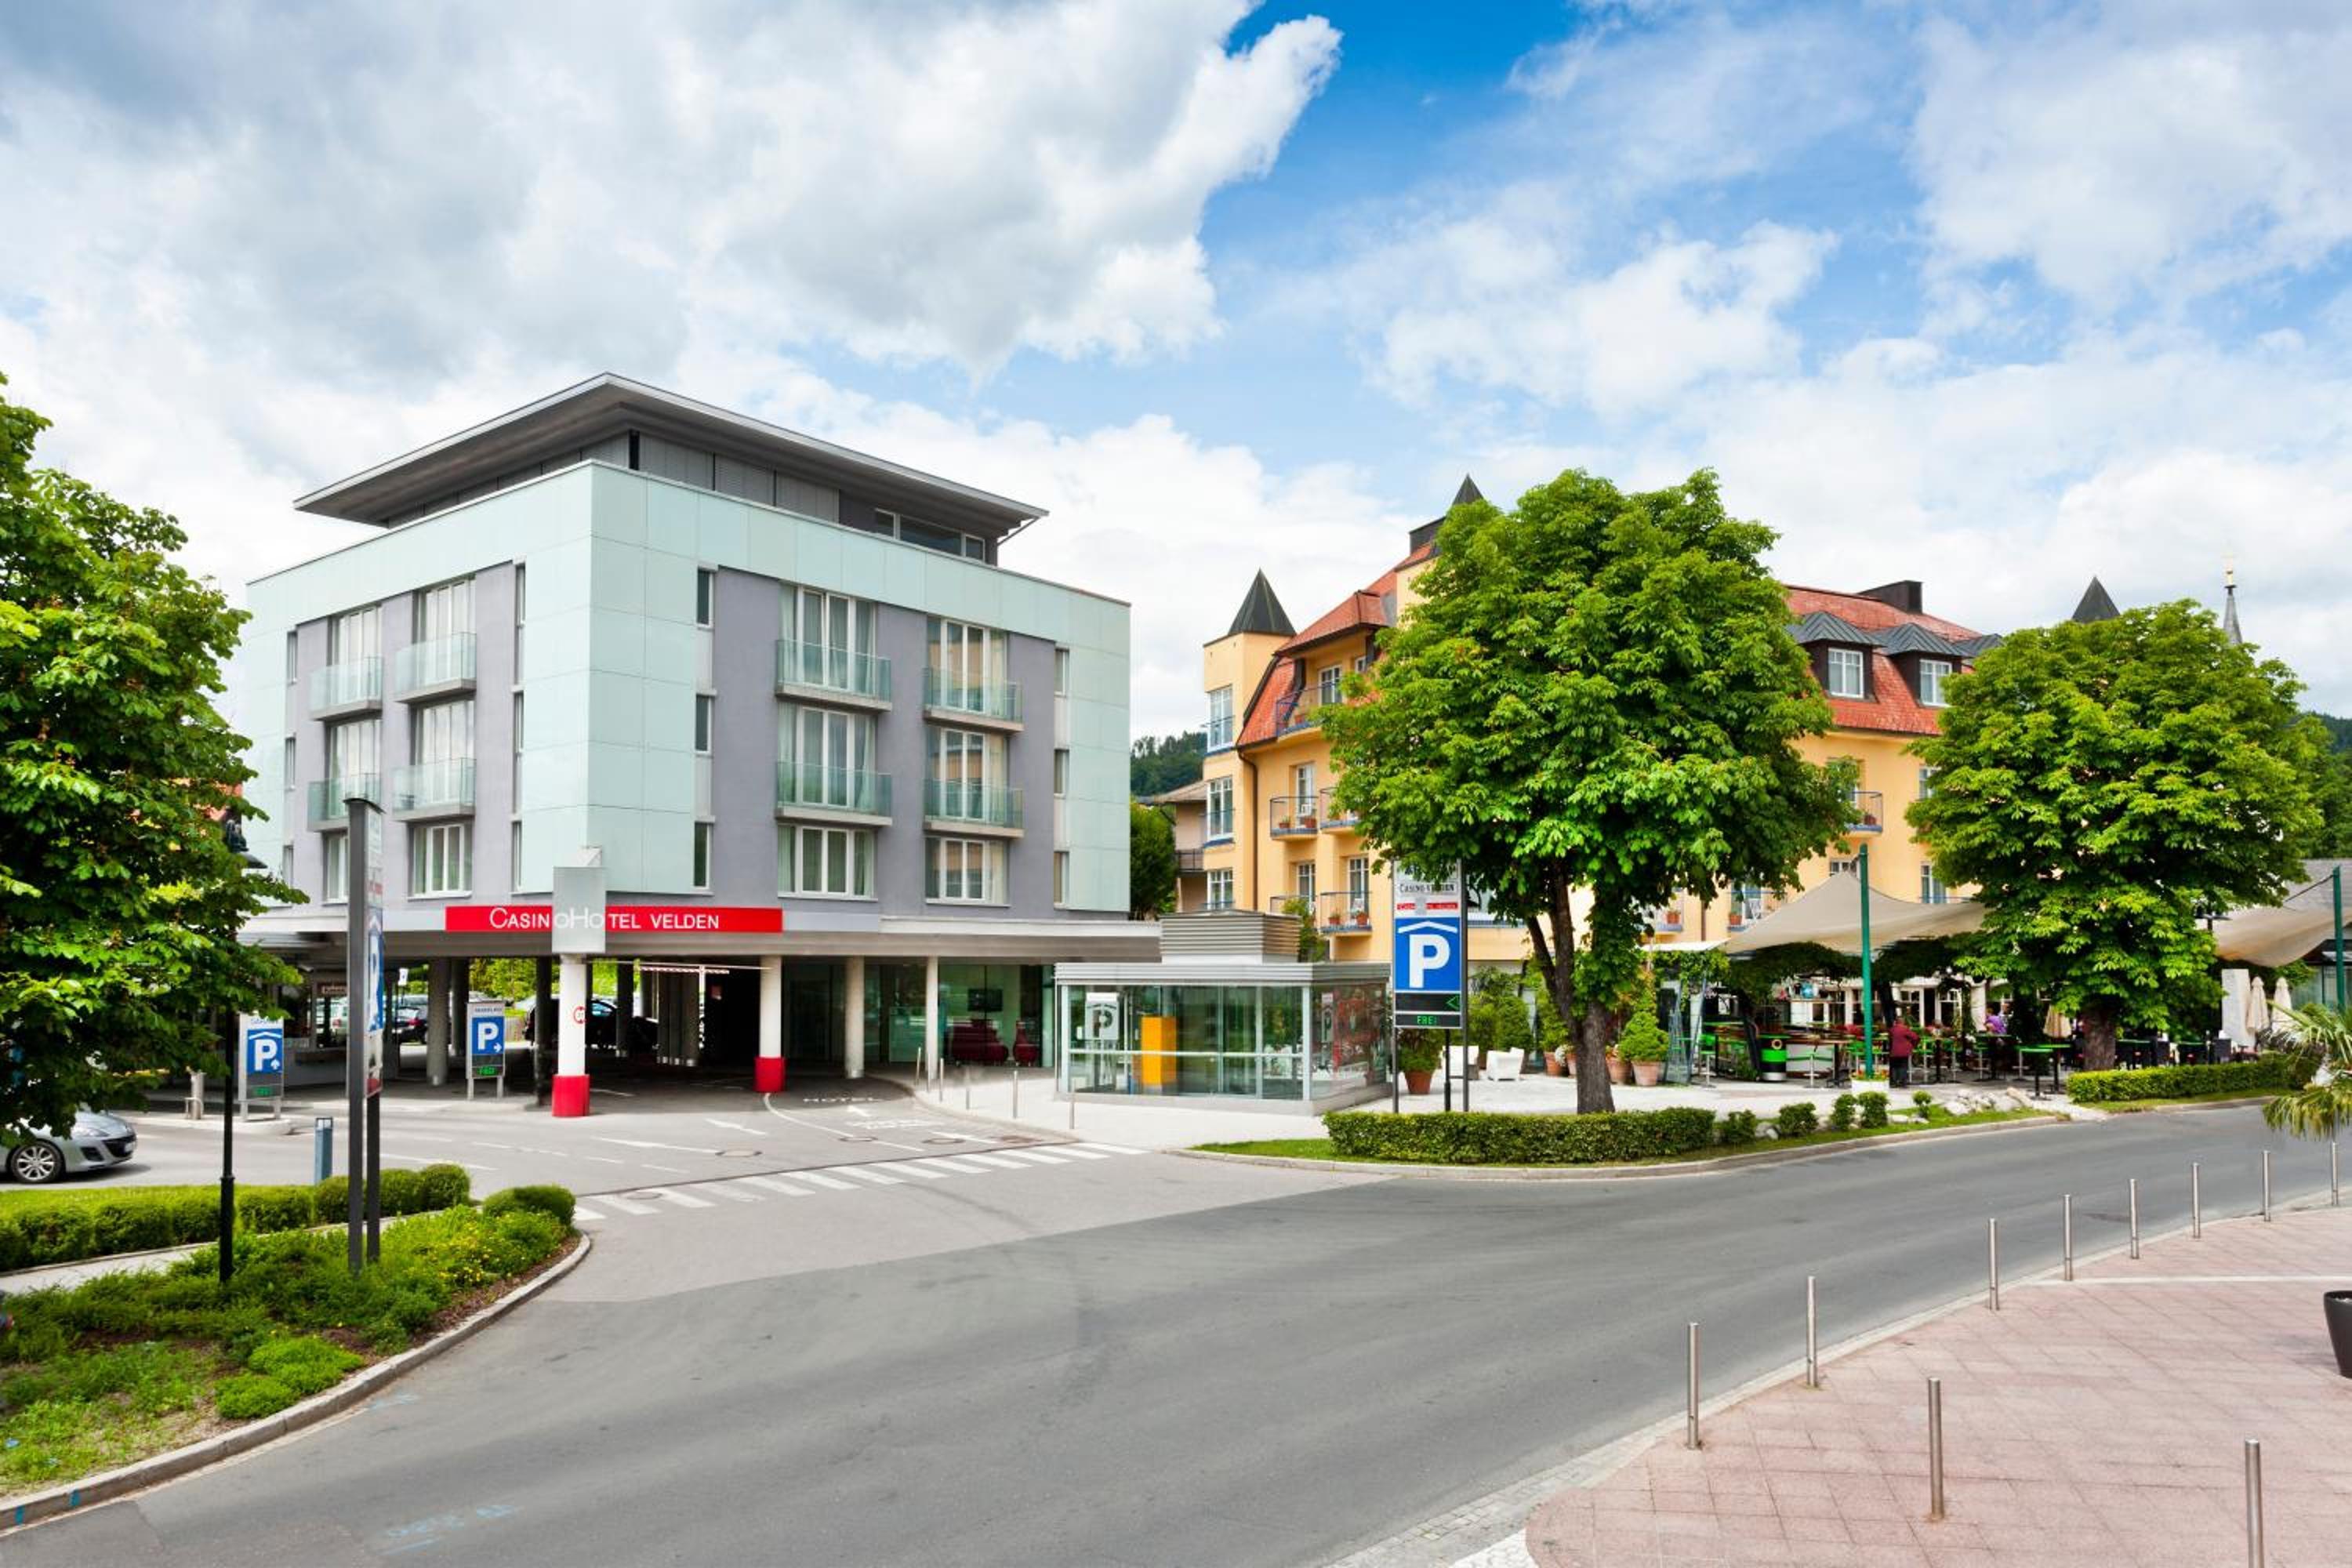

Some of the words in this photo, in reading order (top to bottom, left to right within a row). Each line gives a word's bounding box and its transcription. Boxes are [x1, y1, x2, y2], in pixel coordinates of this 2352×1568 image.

[650, 913, 720, 930] VELDEN
[1409, 934, 1450, 989] P
[477, 1022, 499, 1051] P
[254, 1038, 278, 1071] P
